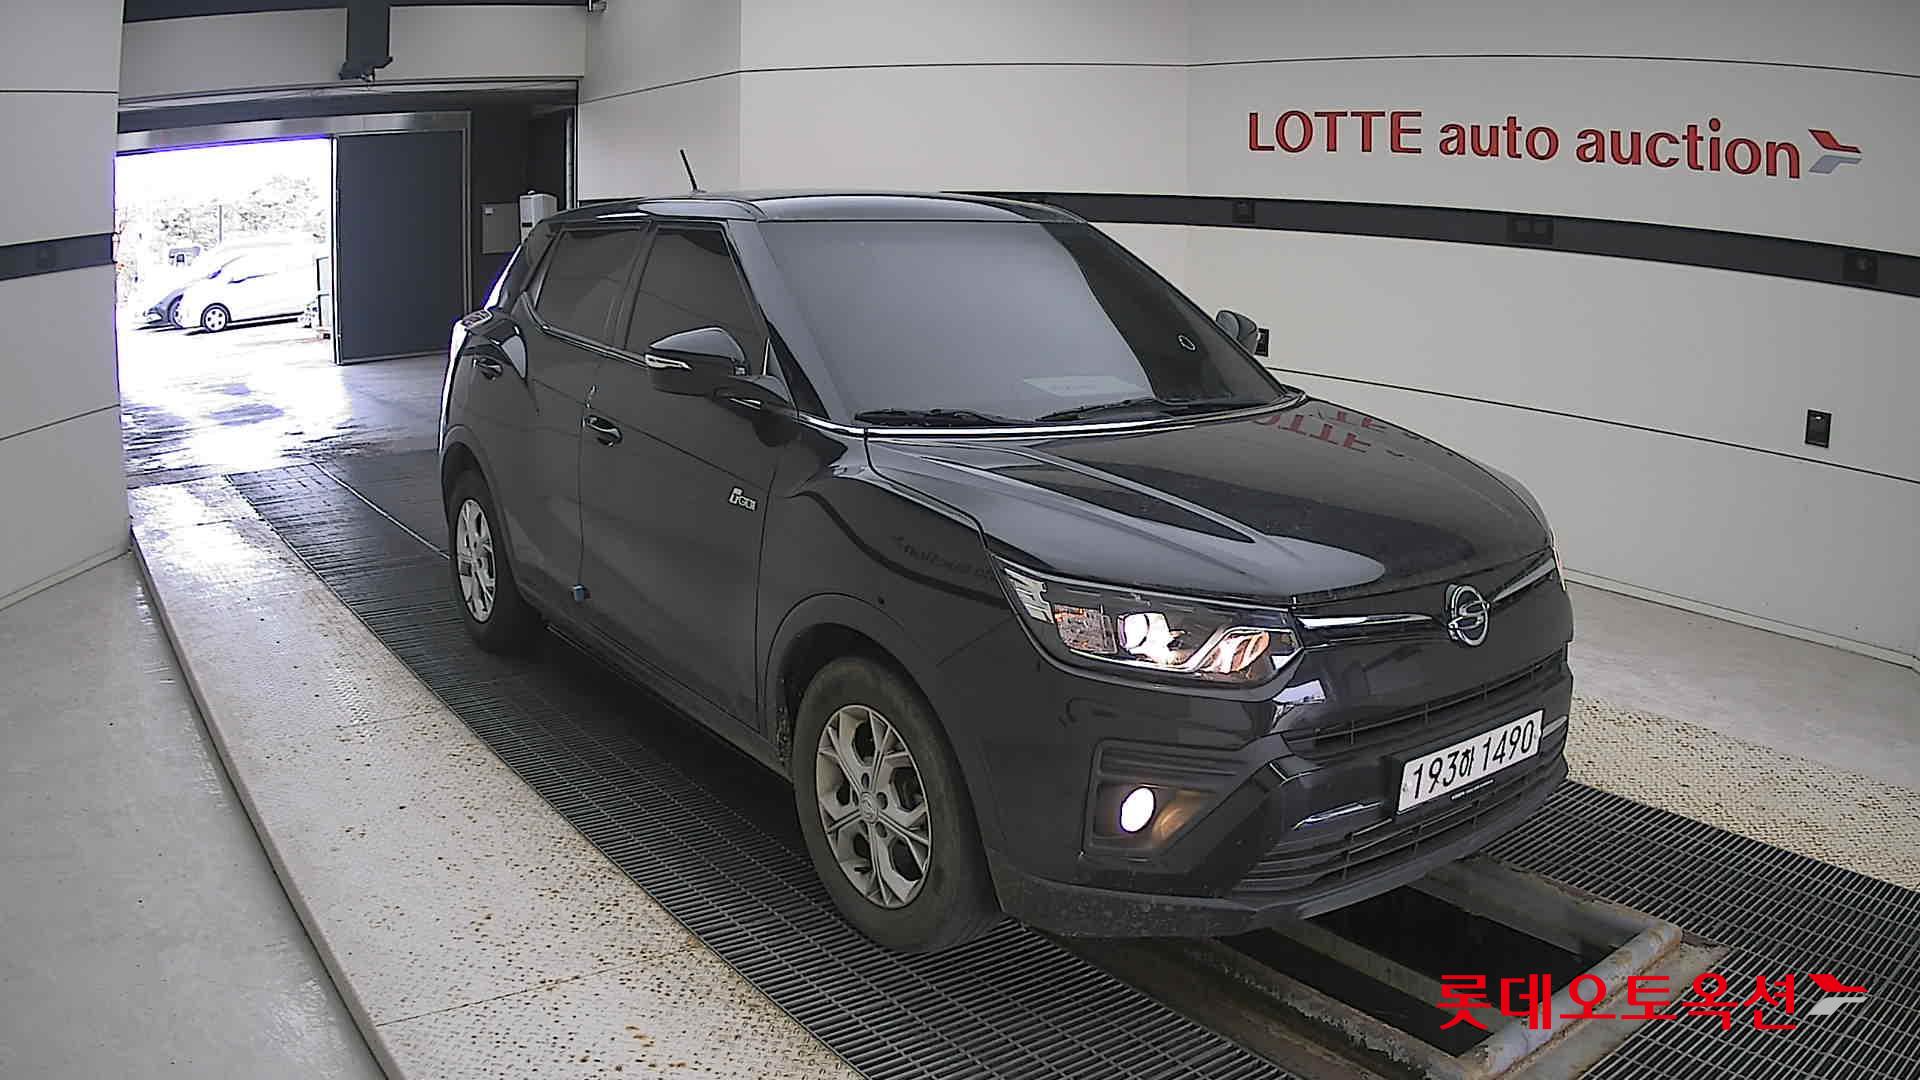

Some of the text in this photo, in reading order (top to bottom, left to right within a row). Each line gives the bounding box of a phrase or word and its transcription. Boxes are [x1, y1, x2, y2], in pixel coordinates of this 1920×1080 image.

[1247, 110, 1801, 179] LOTTE auto auction
[1413, 719, 1535, 799] 193하 1490
